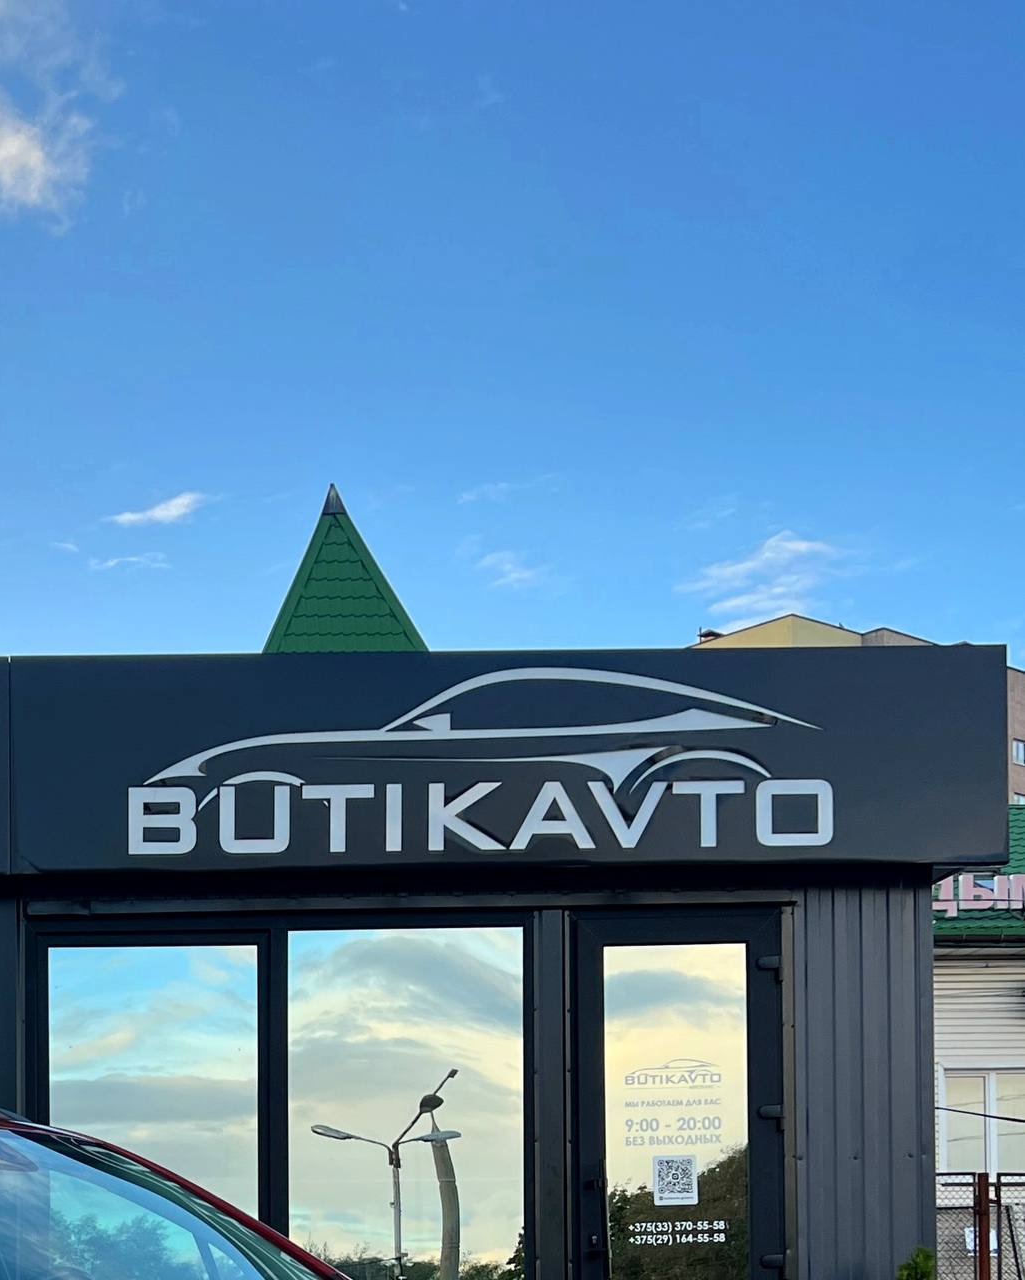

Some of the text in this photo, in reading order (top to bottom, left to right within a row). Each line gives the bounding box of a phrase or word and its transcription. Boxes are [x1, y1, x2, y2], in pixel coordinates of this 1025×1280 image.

[128, 778, 834, 856] BUTIKAVTO
[624, 1072, 722, 1086] BUTIKAVTO
[641, 1099, 684, 1107] РАБОТАЕМ
[685, 1099, 702, 1107] ДЛЯ
[704, 1098, 721, 1106] ВАС
[625, 1118, 659, 1133] 9:00
[677, 1116, 721, 1131] 20:00
[625, 1134, 722, 1146] БЕЗ ВЫХОДНЫХ
[628, 1220, 725, 1233] +375(33) 370-55-58
[628, 1233, 726, 1246] +375(29) 164-55-58
